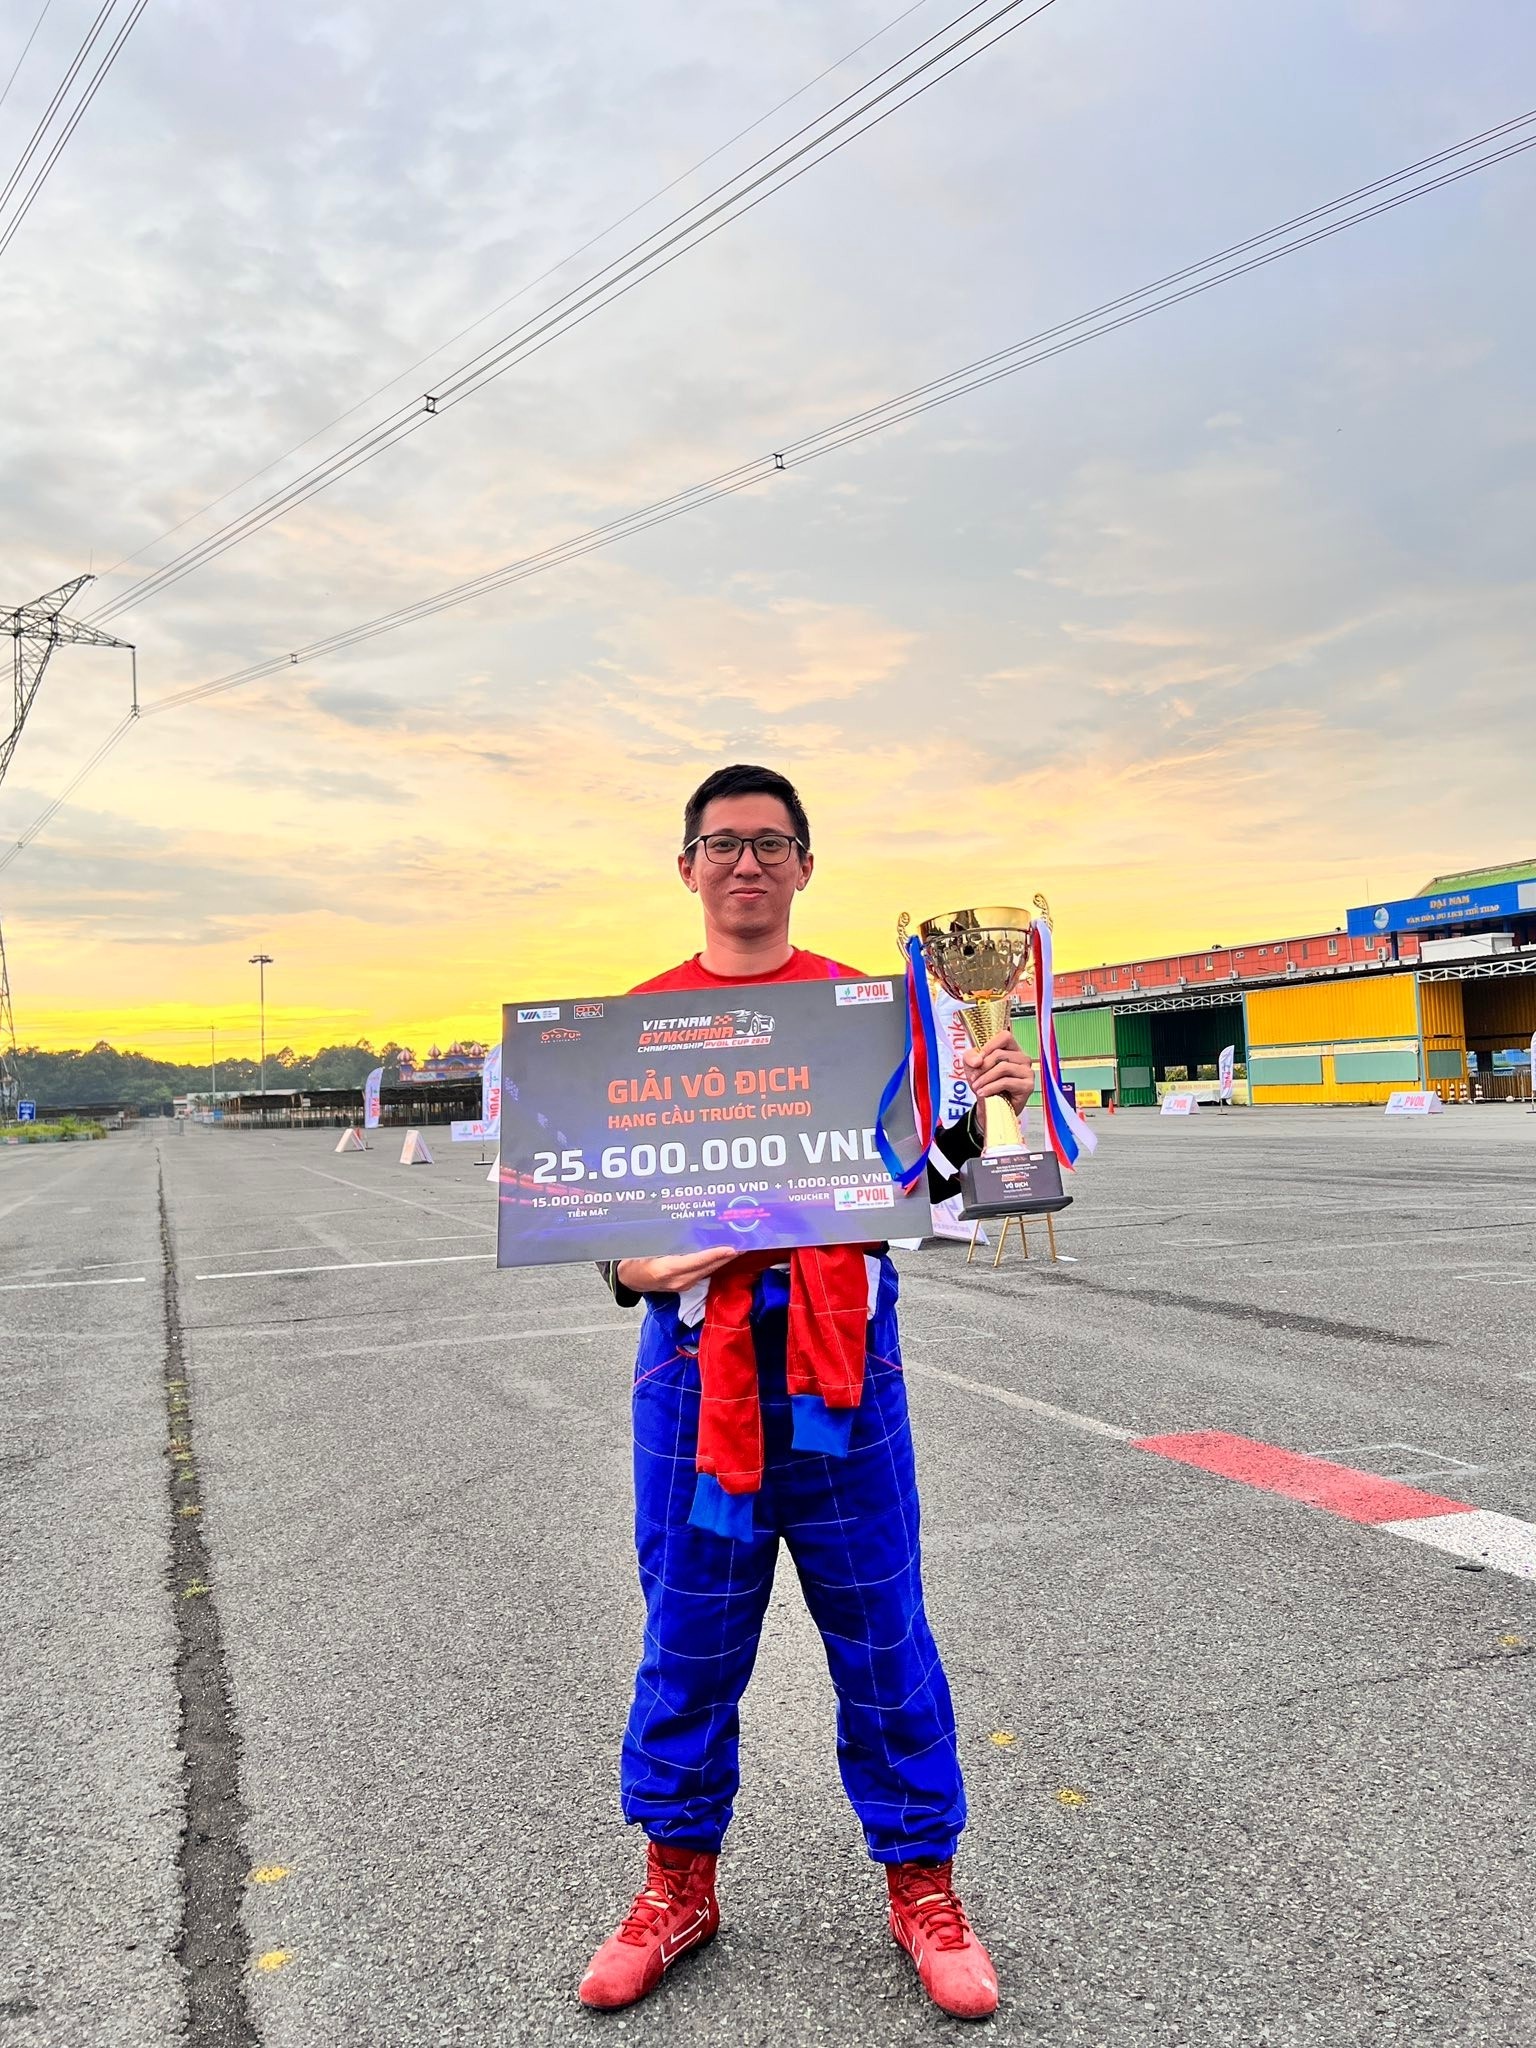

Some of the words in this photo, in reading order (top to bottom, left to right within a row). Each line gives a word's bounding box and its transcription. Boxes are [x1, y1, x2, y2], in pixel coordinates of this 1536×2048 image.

[857, 984, 889, 998] PVOIL
[642, 1016, 712, 1031] VIETNAM
[639, 1027, 734, 1045] GYMKHANA
[637, 1042, 704, 1053] CHAMPIONSHIP
[704, 1040, 730, 1048] PVOIL
[731, 1038, 750, 1047] CUP
[607, 1069, 672, 1104] GIẢI
[680, 1066, 727, 1098] VÔ
[734, 1066, 810, 1100] ĐỊCH
[608, 1112, 657, 1131] HẠNG
[661, 1104, 695, 1125] CẦU
[699, 1102, 757, 1122] TRƯỚC
[761, 1101, 811, 1120] (FWD)
[533, 1134, 787, 1184] 25.600.000
[531, 1192, 613, 1208] 15.000.000
[615, 1190, 646, 1202] VND
[660, 1183, 736, 1199] 9.600.000
[739, 1181, 769, 1193] VND
[787, 1173, 859, 1190] 1.000.000
[862, 1172, 892, 1185] VND
[788, 1192, 830, 1202] VOUCHER
[857, 1187, 889, 1202] PVOIL
